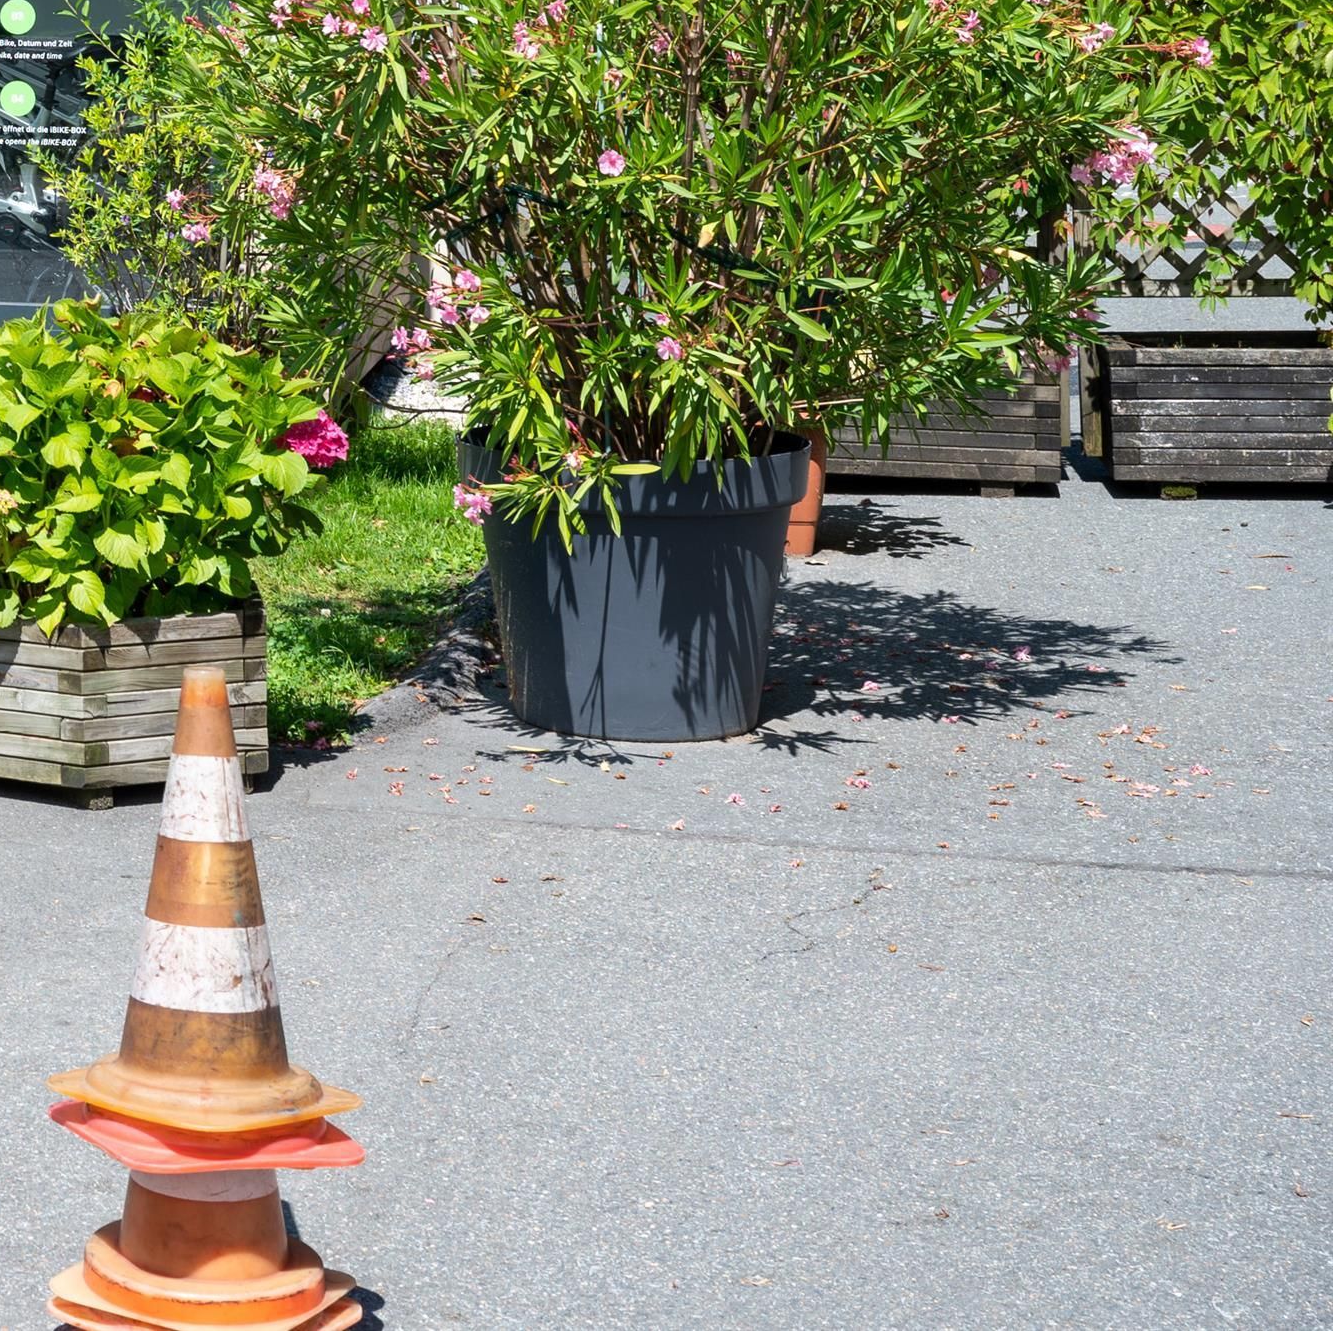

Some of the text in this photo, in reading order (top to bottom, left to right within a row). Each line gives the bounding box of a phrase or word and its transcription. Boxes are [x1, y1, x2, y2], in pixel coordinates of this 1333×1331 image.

[0, 39, 17, 48] Bike,
[18, 39, 41, 48] Datum
[43, 39, 56, 48] und
[58, 40, 73, 48] Zeit
[14, 52, 30, 60] date
[32, 52, 45, 60] and
[47, 52, 63, 60] time
[2, 124, 24, 133] öffnet
[25, 125, 36, 133] dir
[37, 125, 48, 133] die
[49, 126, 87, 134] iBIKE-BOX
[5, 138, 26, 147] opens
[27, 138, 39, 146] the
